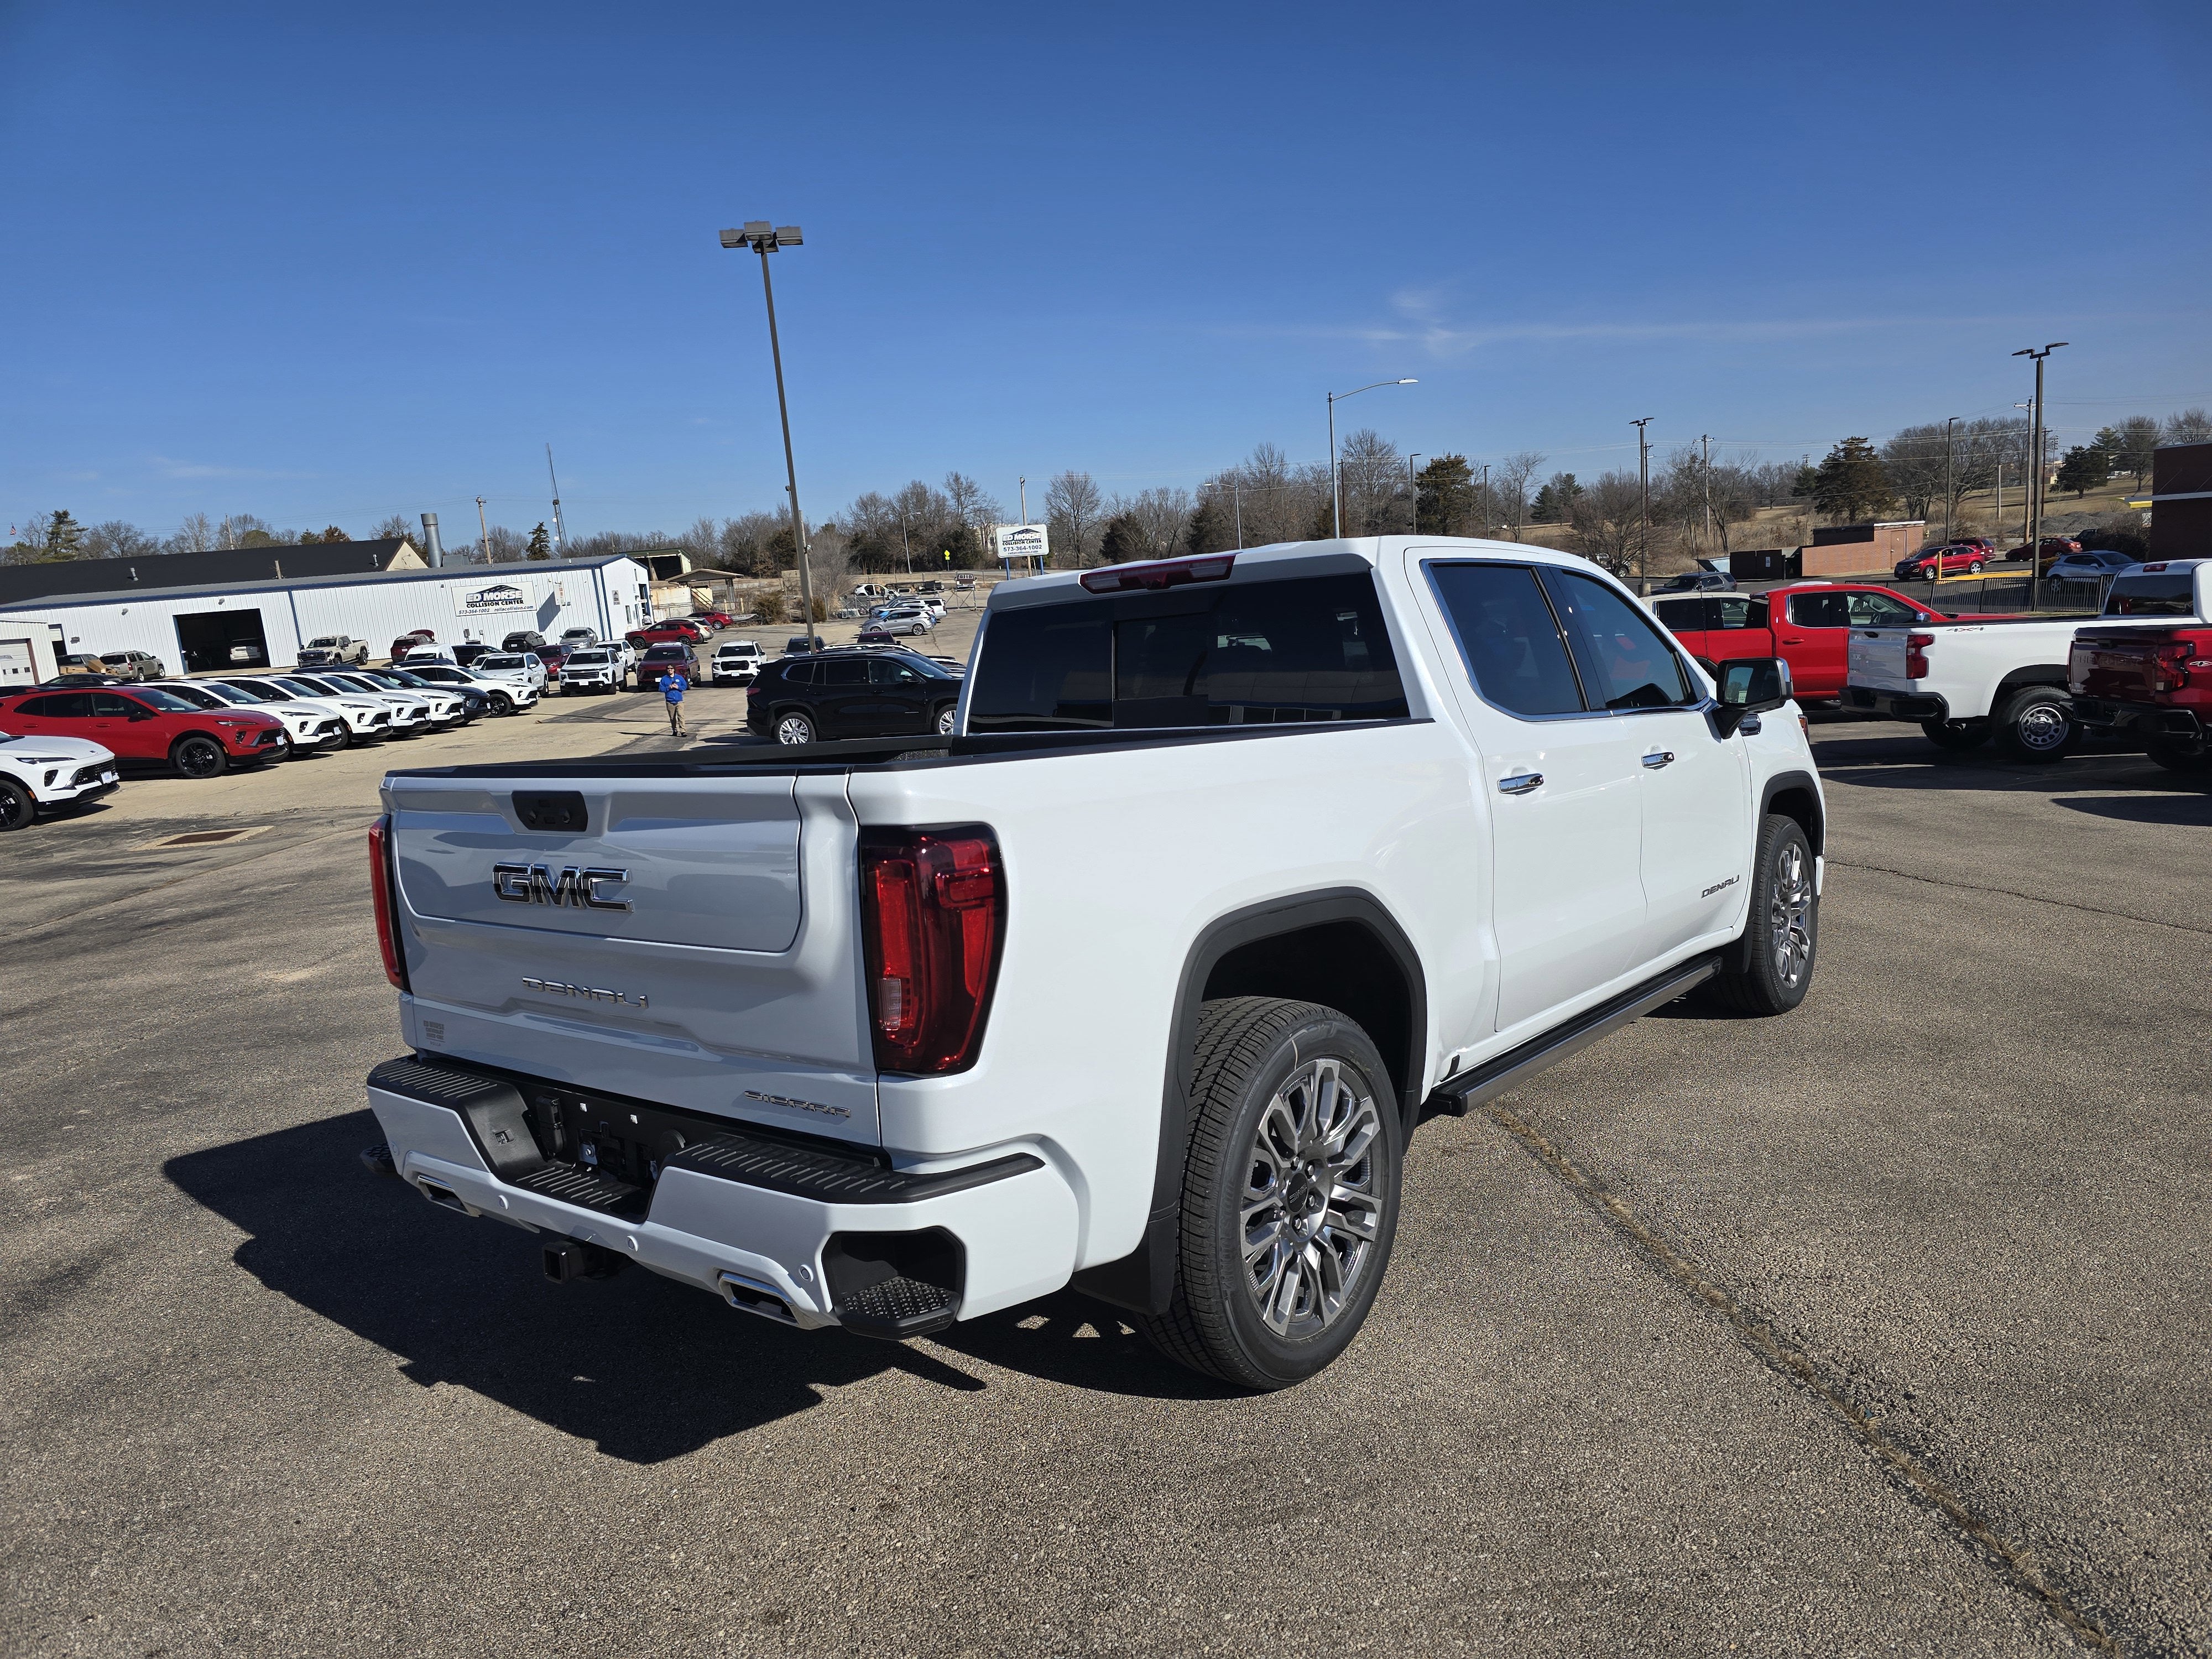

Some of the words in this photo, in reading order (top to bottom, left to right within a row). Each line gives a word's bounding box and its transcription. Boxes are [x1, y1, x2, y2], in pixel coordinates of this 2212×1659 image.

[466, 593, 482, 603] ED
[483, 589, 523, 602] MORSE
[492, 862, 635, 913] GMC
[1701, 874, 1740, 899] DENALI
[523, 976, 648, 1009] DENALI
[744, 1091, 851, 1118] SIERRA
